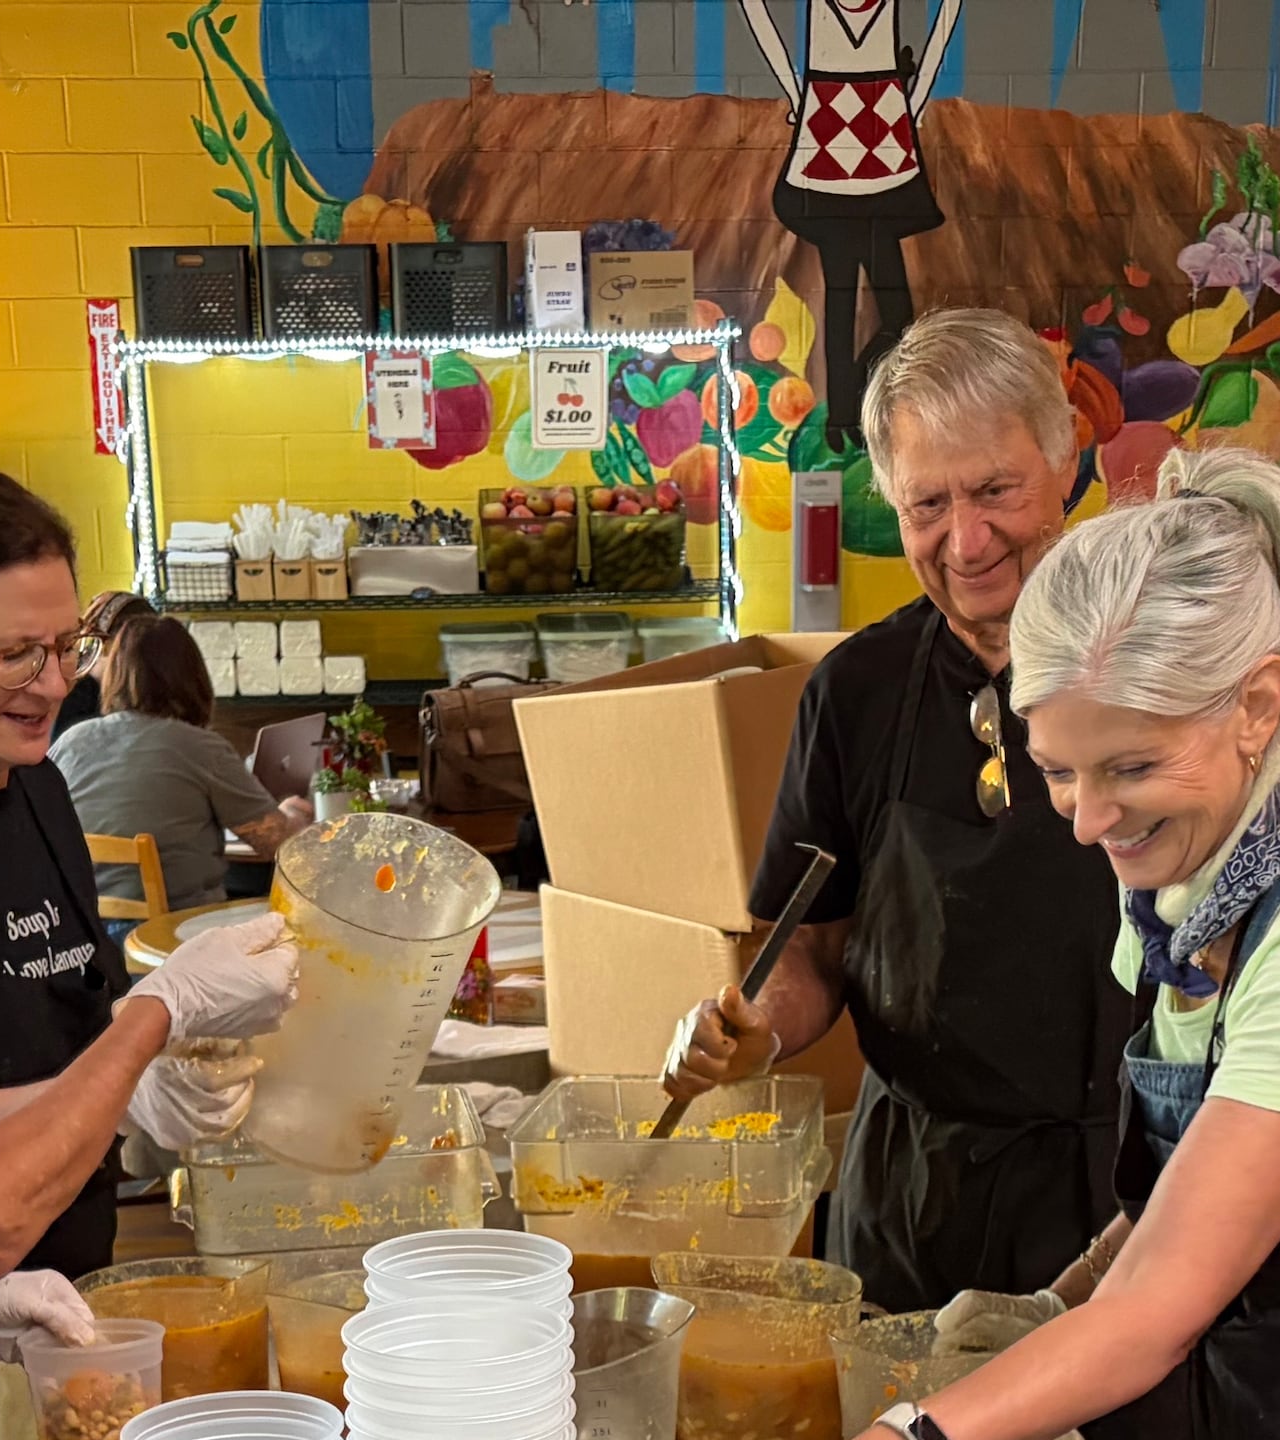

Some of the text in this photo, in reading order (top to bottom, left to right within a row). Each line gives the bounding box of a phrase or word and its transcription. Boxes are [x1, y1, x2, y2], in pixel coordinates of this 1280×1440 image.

[92, 313, 115, 329] FIRE
[547, 359, 592, 374] Fruit
[101, 334, 115, 443] EXTINGUISHER
[544, 409, 593, 424] $1.00
[6, 910, 50, 940] Soup
